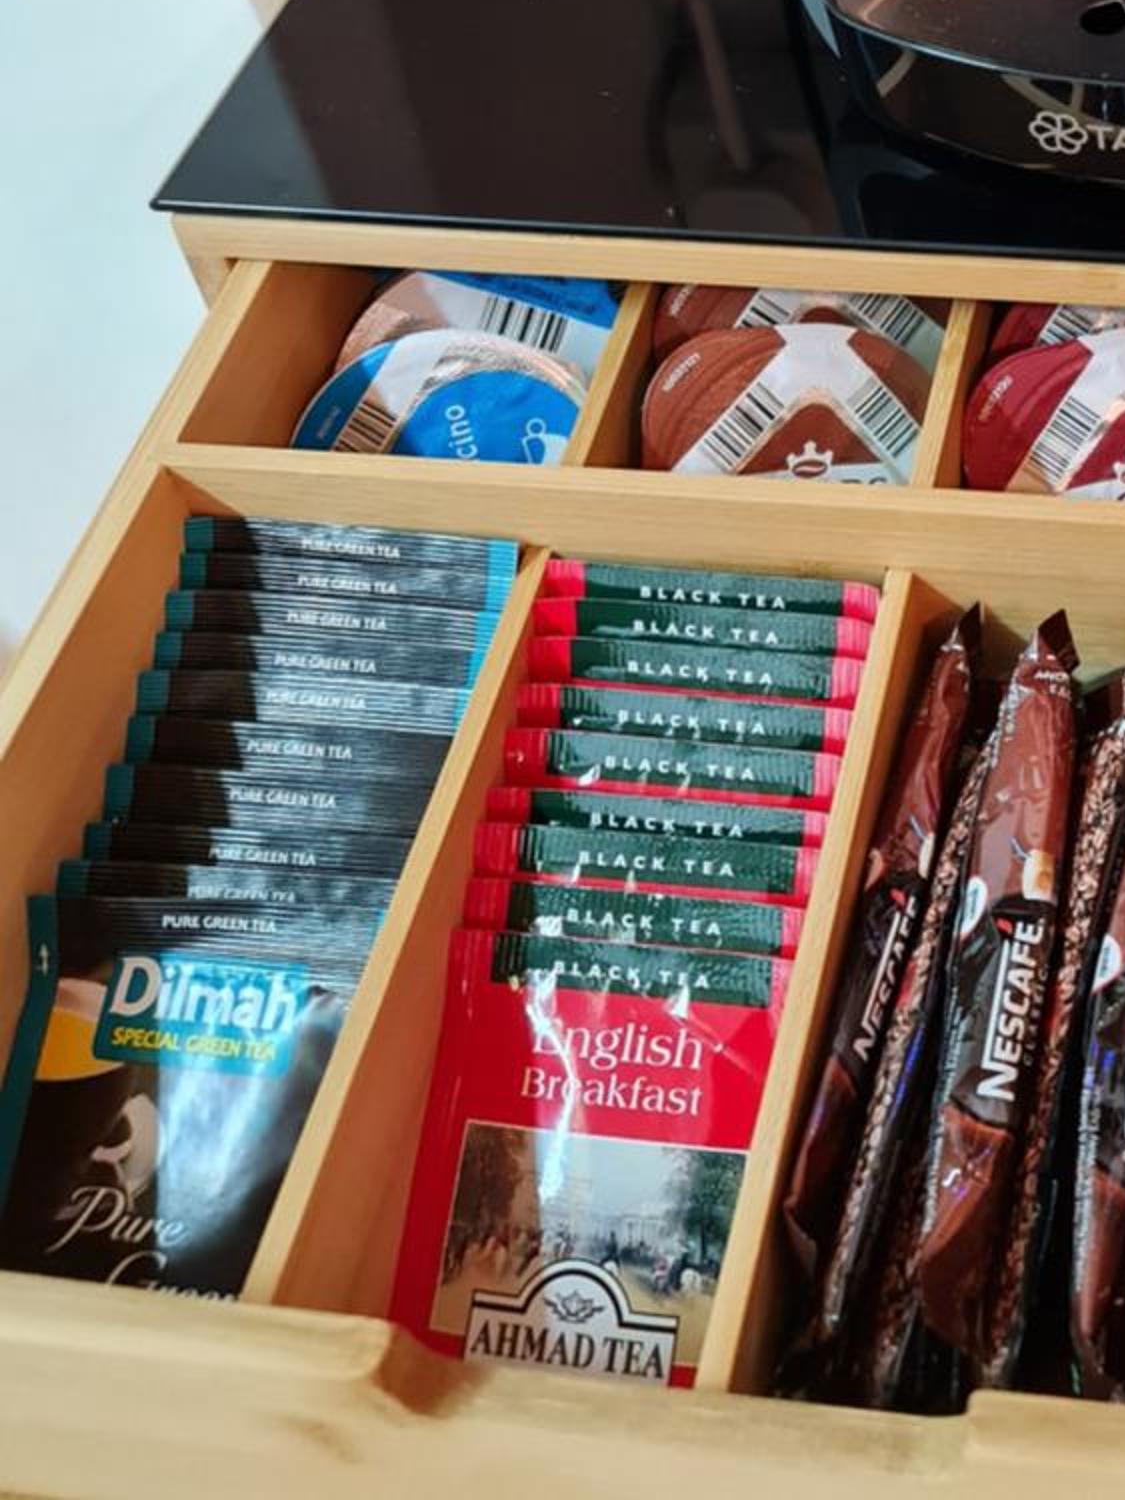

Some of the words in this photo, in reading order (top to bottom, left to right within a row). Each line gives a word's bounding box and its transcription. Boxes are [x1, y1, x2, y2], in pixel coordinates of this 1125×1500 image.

[640, 585, 721, 605] BLACK
[737, 593, 786, 610] TEA
[632, 619, 716, 639] BLACK
[730, 628, 779, 645] TEA
[274, 653, 304, 666] PURE
[305, 656, 350, 672] GREEN
[353, 660, 377, 674] TEA
[627, 660, 709, 680] BLACK
[726, 668, 773, 685] TEA
[617, 709, 699, 729] BLACK
[717, 718, 765, 735] TEA
[248, 740, 280, 753] PURE
[282, 742, 325, 758] GREEN
[328, 745, 353, 760] TEA
[605, 755, 689, 775] BLACK
[706, 763, 755, 781] TEA
[229, 788, 263, 801] PURE
[266, 790, 311, 806] GREEN
[313, 794, 337, 809] TEA
[590, 811, 676, 832] BLACK
[694, 821, 744, 838] TEA
[209, 847, 243, 861] PURE
[245, 850, 290, 865] GREEN
[292, 852, 317, 867] TEA
[579, 851, 665, 872] BLACK
[683, 859, 734, 877] TEA
[161, 915, 201, 929] PURE
[202, 917, 251, 932] GREEN
[252, 919, 277, 933] TEA
[567, 908, 653, 929] BLACK
[672, 918, 721, 936] TEA
[554, 960, 640, 984] BLACK
[659, 970, 710, 989] TEA
[109, 956, 297, 1034] Dilmah
[112, 1027, 179, 1050] SPECIAL
[185, 1034, 242, 1059] GREEN
[533, 1022, 703, 1071] English
[520, 1066, 703, 1116] Breakfast
[47, 1185, 188, 1255] Pure
[470, 1319, 596, 1369] AHMAD
[603, 1336, 665, 1379] TEA
